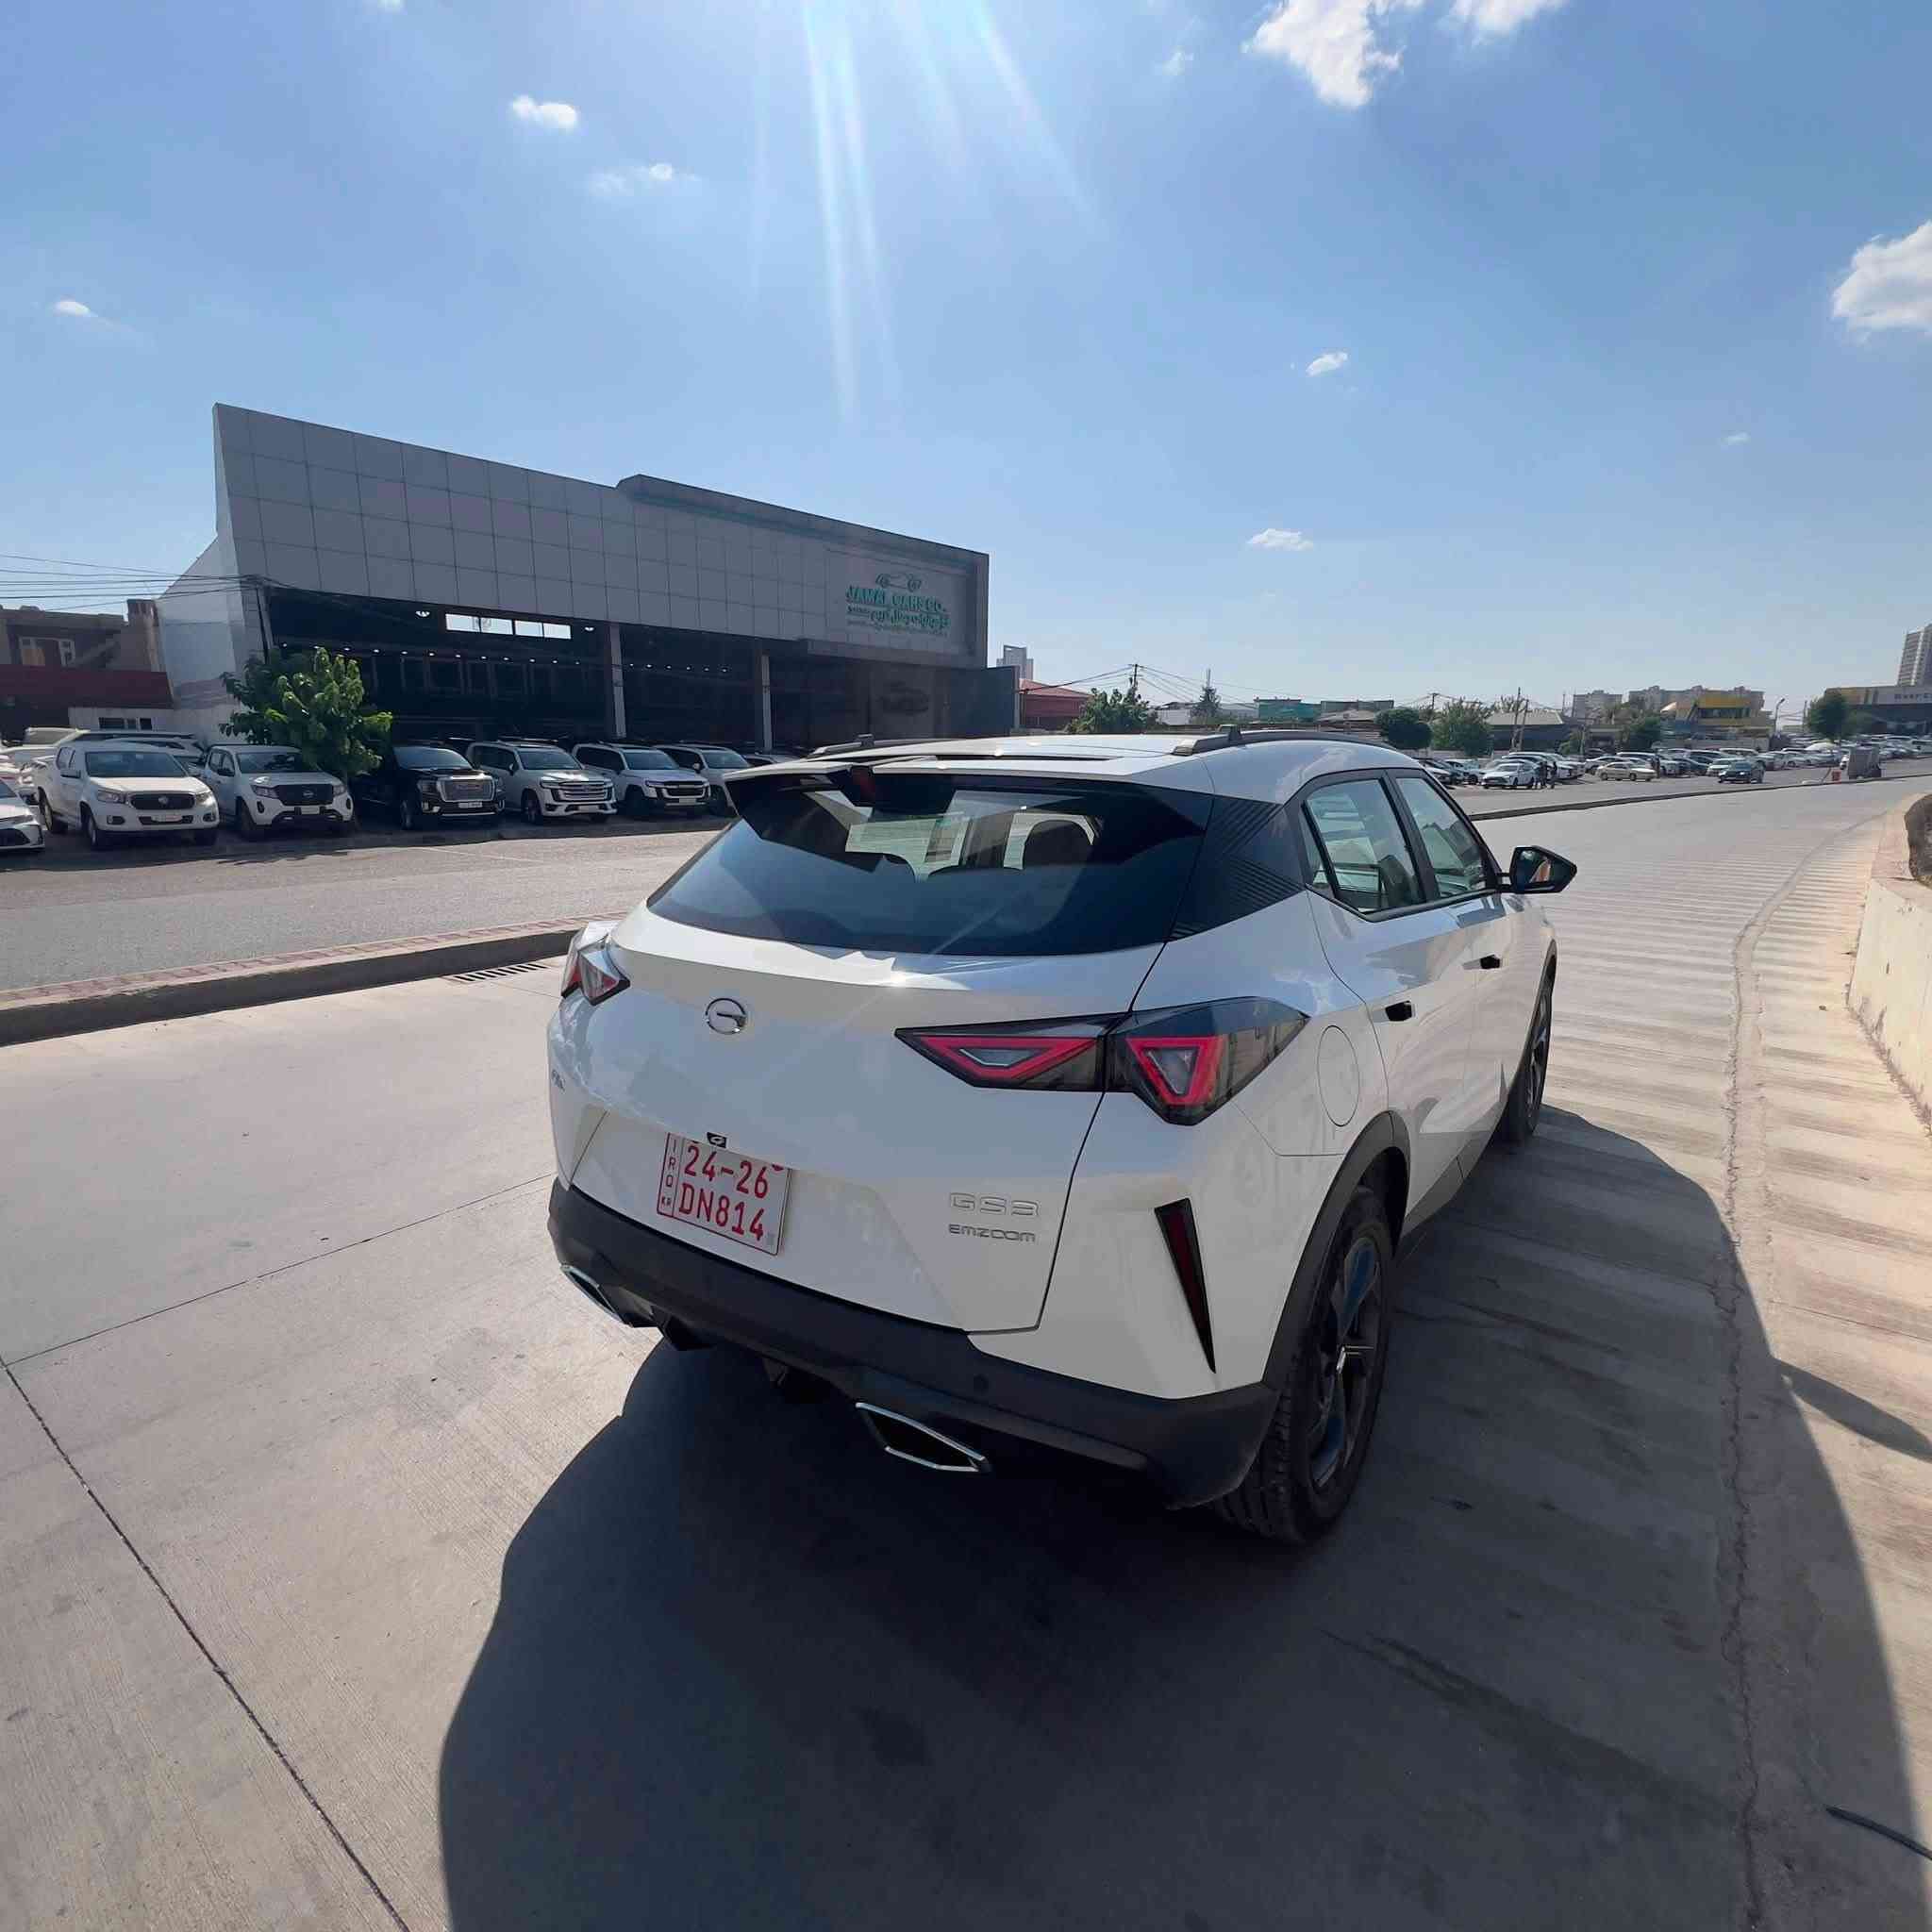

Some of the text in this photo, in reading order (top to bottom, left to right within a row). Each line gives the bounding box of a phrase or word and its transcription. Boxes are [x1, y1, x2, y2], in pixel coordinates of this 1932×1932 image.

[684, 1145, 770, 1199] 24-26
[679, 1182, 765, 1241] DN814
[950, 1192, 1041, 1220] GS3
[948, 1224, 1036, 1242] EMZOOM
